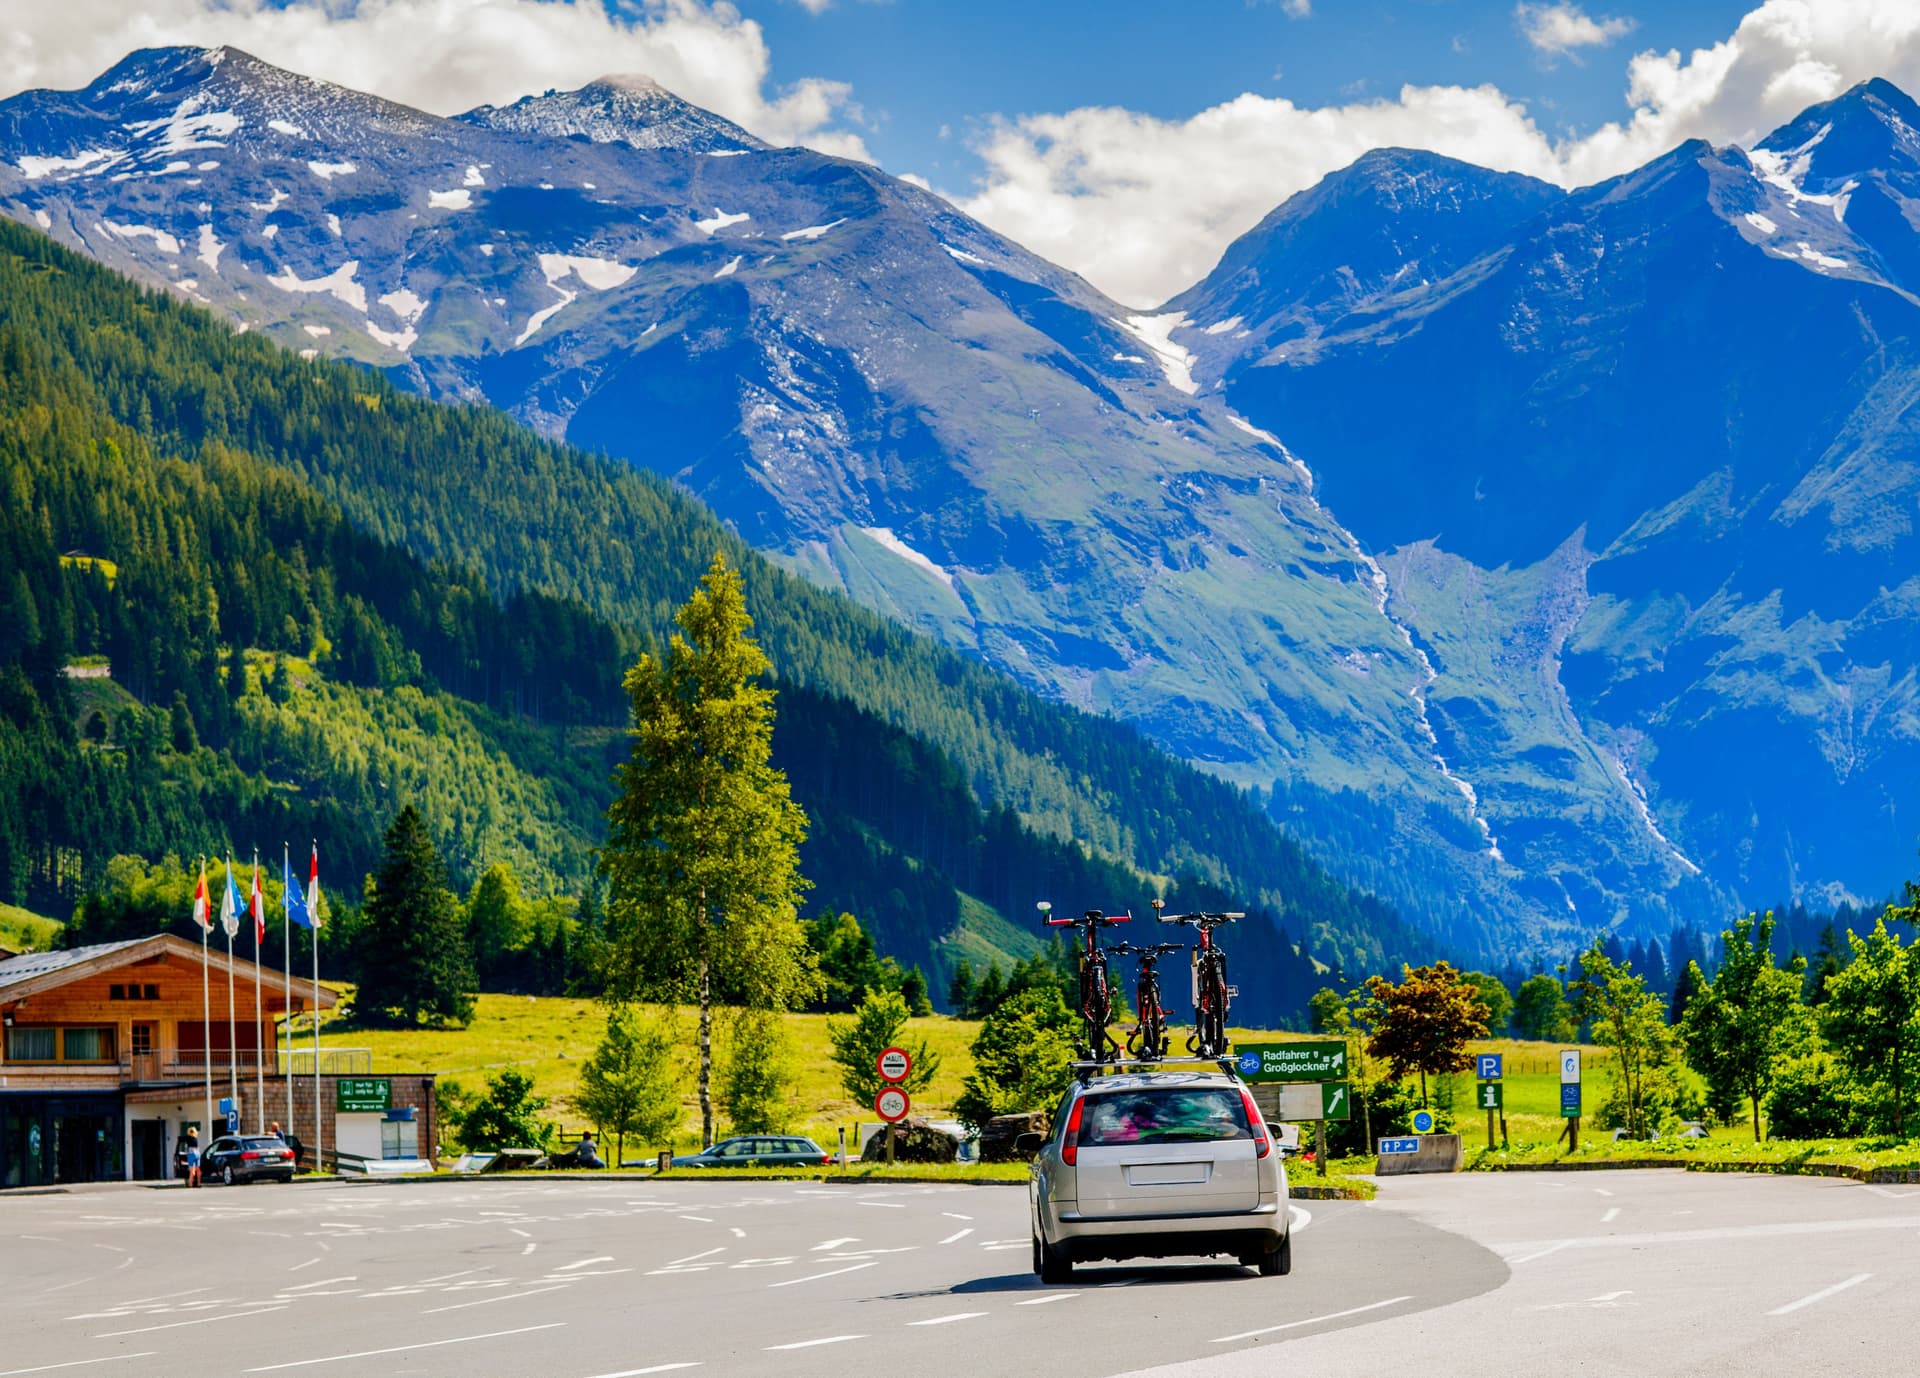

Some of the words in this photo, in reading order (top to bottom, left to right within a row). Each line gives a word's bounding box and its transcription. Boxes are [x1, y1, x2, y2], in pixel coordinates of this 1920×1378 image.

[1263, 1050, 1310, 1060] Radfahrer
[1264, 1062, 1329, 1073] Großglockner
[1482, 1058, 1497, 1076] P
[228, 1112, 237, 1129] P
[1394, 1141, 1401, 1151] P
